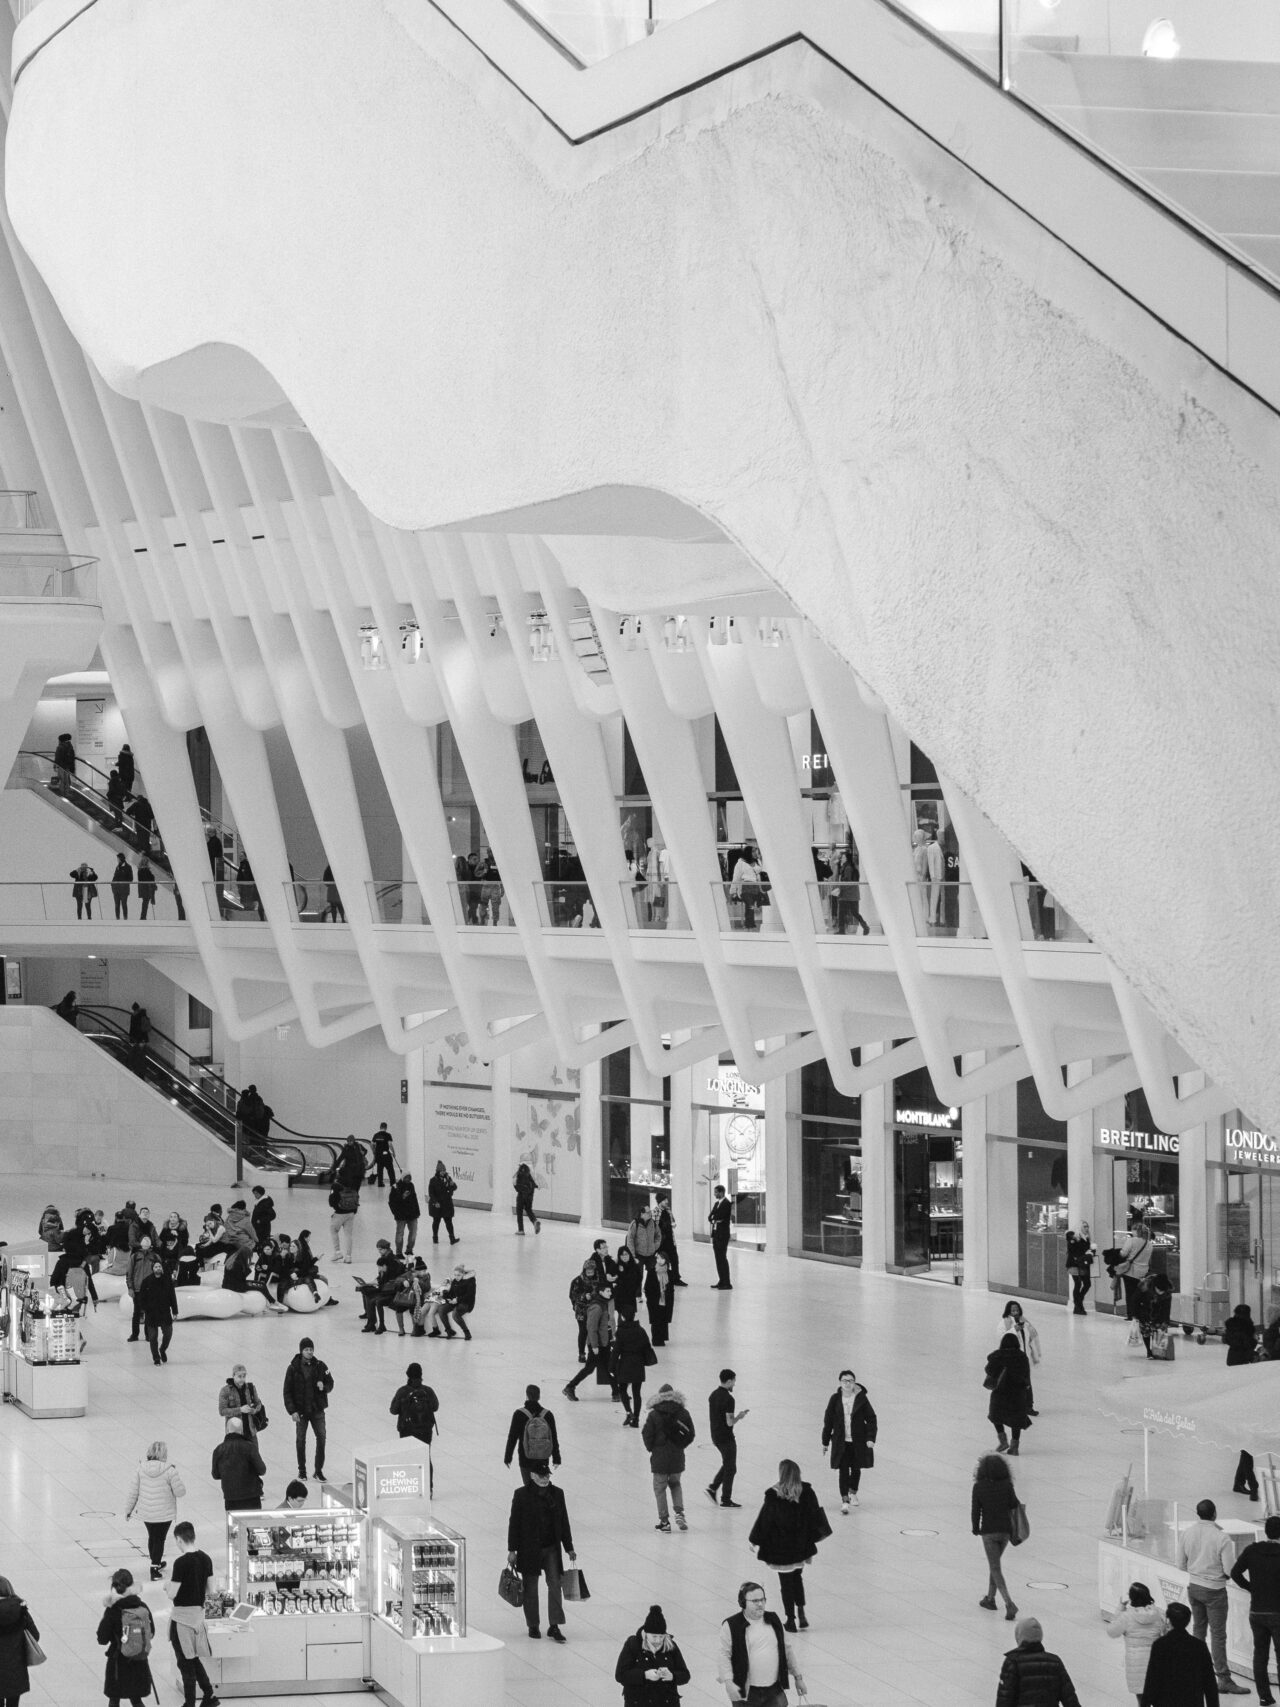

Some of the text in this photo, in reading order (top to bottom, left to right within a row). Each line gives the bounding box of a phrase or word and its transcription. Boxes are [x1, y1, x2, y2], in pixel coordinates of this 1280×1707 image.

[896, 1109, 952, 1128] MONTBLANC
[1100, 1128, 1180, 1153] BREITLING
[392, 1470, 406, 1478] NO
[380, 1477, 419, 1487] CHEWING
[380, 1485, 419, 1494] ALLOWED
